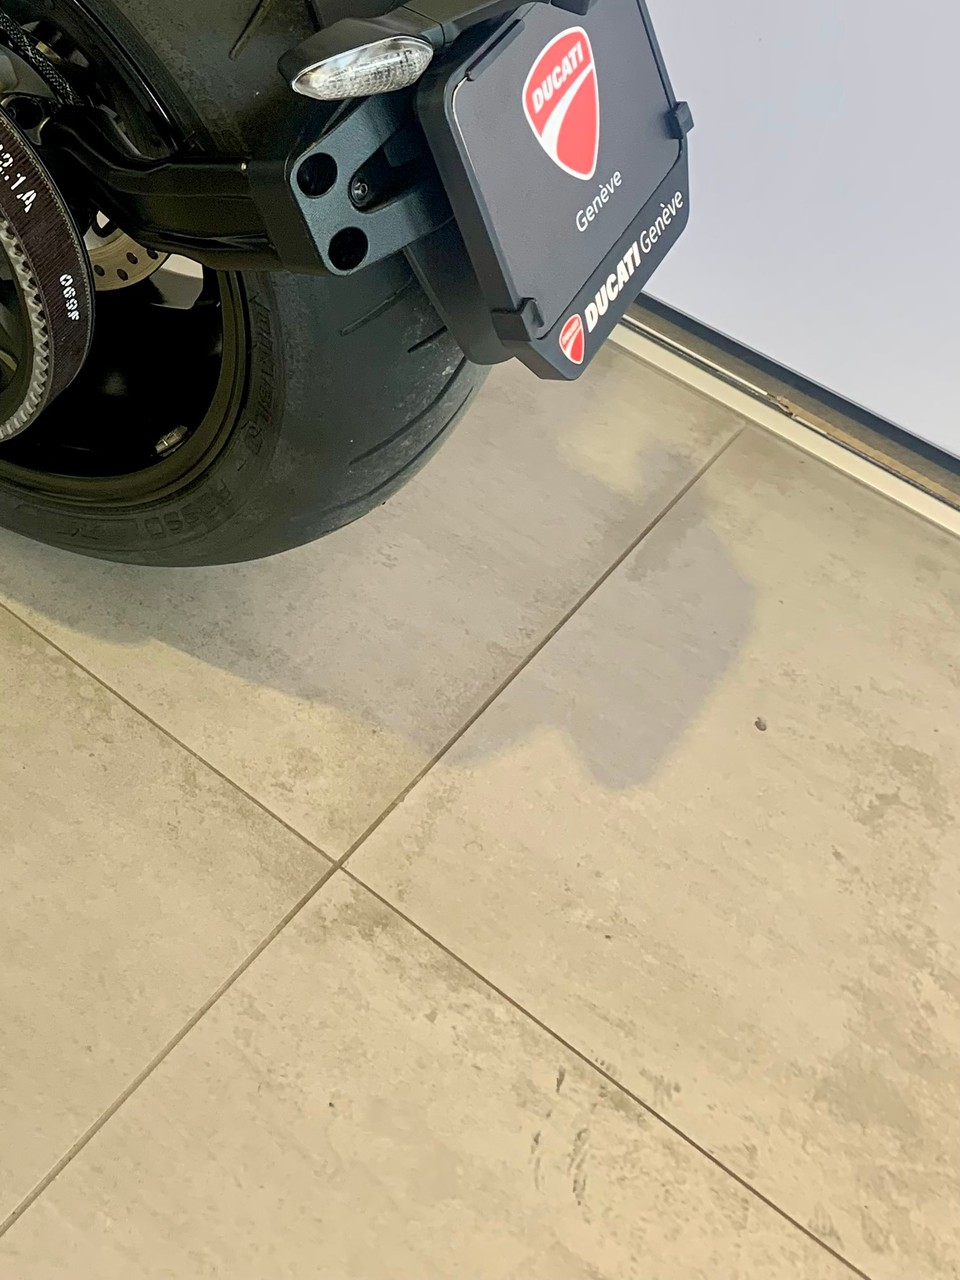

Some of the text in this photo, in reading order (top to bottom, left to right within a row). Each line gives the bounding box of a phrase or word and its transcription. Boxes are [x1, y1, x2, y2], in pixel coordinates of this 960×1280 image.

[531, 41, 583, 113] DUCATI
[575, 171, 622, 232] Genève
[584, 191, 684, 333] DUCATI Genève
